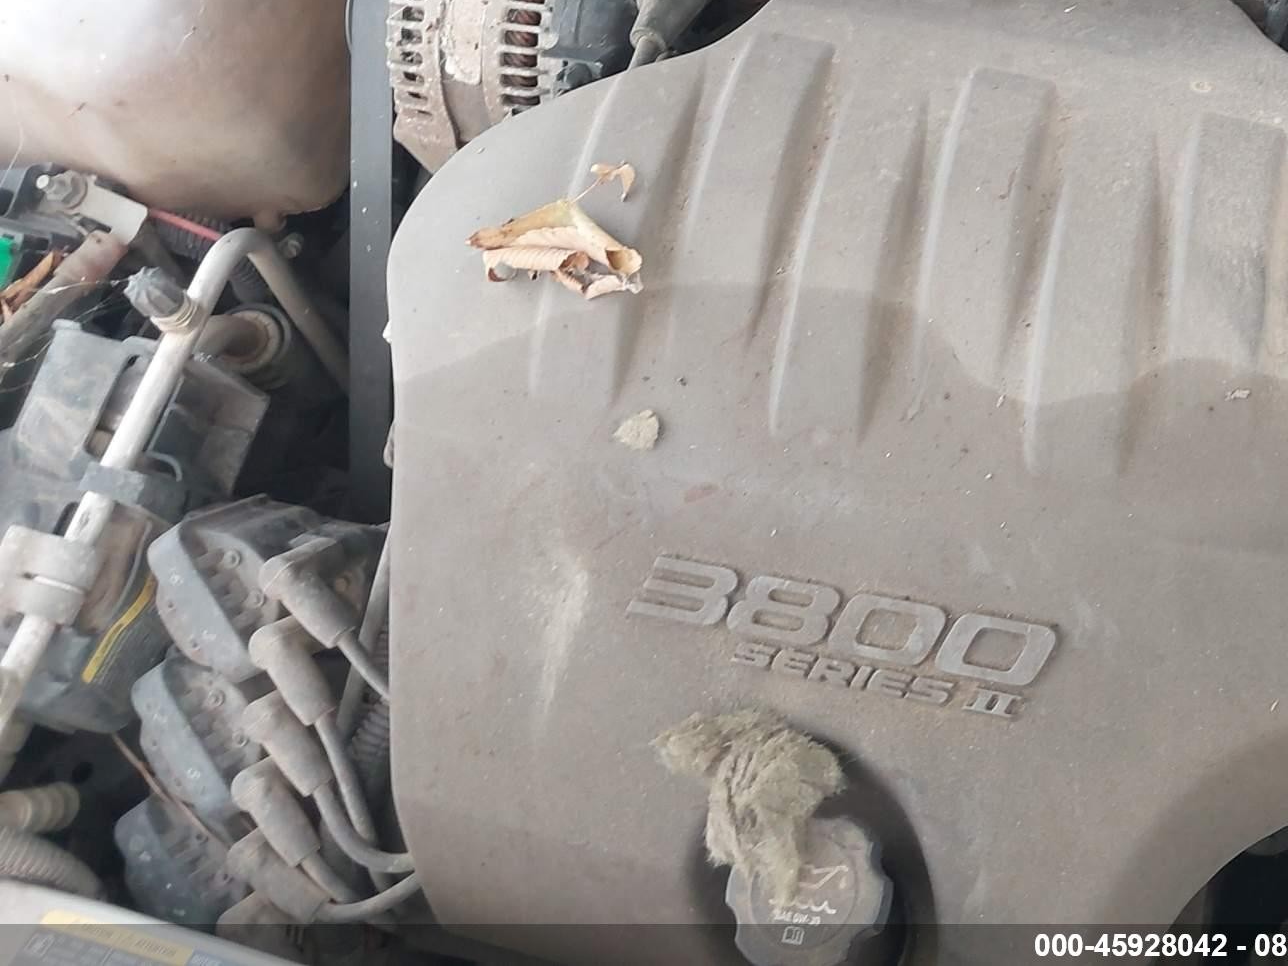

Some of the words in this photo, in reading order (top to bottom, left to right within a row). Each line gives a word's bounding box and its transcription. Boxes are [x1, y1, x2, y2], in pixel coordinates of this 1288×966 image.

[625, 554, 1057, 686] 3800
[731, 641, 955, 706] SERIES
[962, 687, 1023, 718] II
